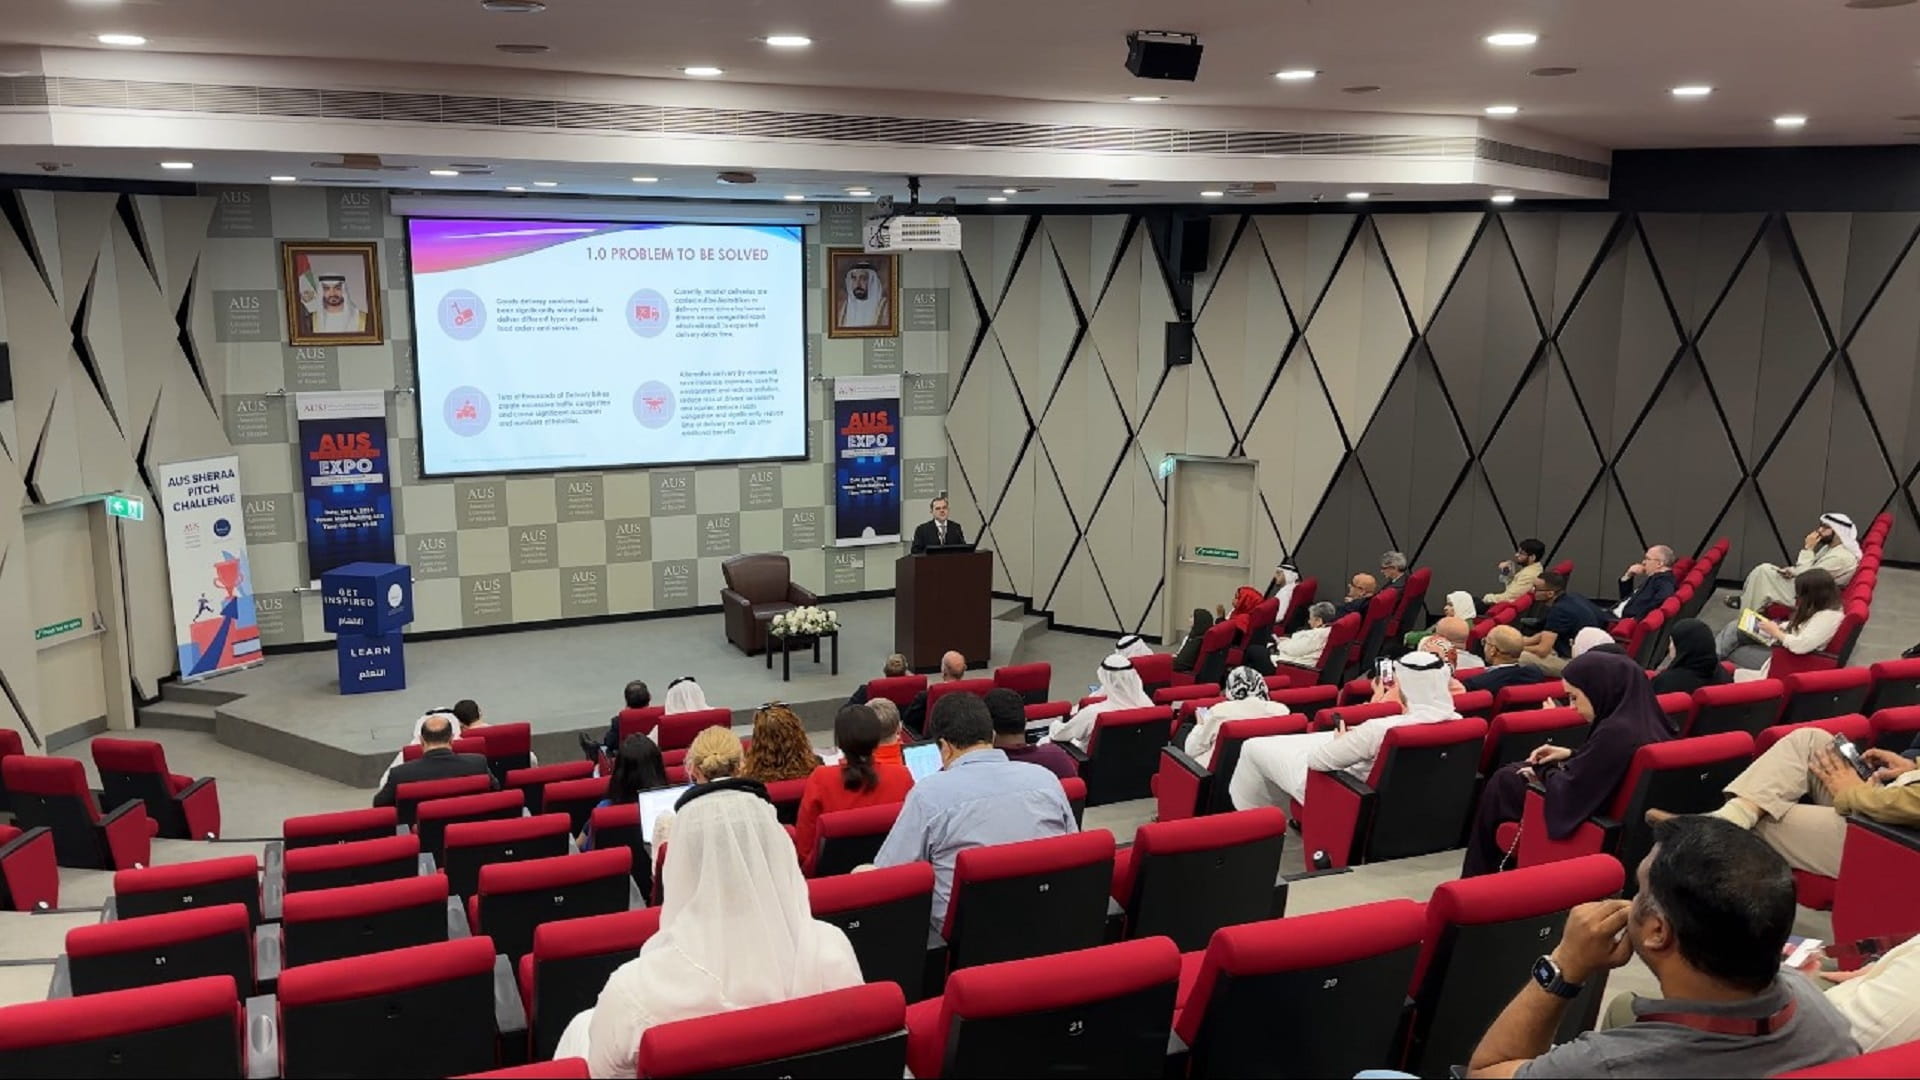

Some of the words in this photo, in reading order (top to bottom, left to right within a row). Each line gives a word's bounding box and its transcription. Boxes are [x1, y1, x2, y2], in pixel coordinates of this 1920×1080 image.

[220, 192, 250, 203] AUS
[341, 193, 370, 204] AUS
[587, 248, 606, 260] 1.0
[612, 248, 674, 260] PROBLEM
[677, 248, 695, 260] TO
[700, 248, 714, 260] BE
[718, 248, 768, 260] SOLVED
[230, 297, 259, 309] AUS
[914, 294, 935, 304] AUS
[873, 339, 895, 348] AUS
[296, 349, 326, 359] AUS
[913, 380, 935, 389] AUS
[237, 401, 267, 412] AUS
[849, 411, 888, 428] AUS
[319, 432, 371, 450] AUS
[848, 434, 888, 448] EXPO
[319, 458, 373, 475] EXPO
[914, 463, 935, 472] AUS
[168, 474, 190, 487] AUS
[192, 469, 235, 484] SHERAA
[750, 472, 773, 482] AUS
[568, 482, 592, 493] AUS
[661, 478, 686, 488] AUS
[188, 484, 219, 497] PITCH
[468, 487, 494, 499] AUS
[173, 494, 236, 512] CHALLENGE
[246, 501, 274, 512] AUS
[706, 518, 730, 529] AUS
[793, 513, 815, 523] AUS
[616, 524, 640, 535] AUS
[520, 530, 547, 542] AUS
[418, 538, 446, 550] AUS
[834, 554, 856, 564] AUS
[664, 565, 688, 576] AUS
[572, 572, 597, 583] AUS
[473, 579, 500, 592] AUS
[339, 588, 358, 596] GET
[324, 596, 374, 607] INSPIRED
[351, 646, 390, 657] LEARN
[1323, 978, 1338, 988] 20
[1069, 1020, 1083, 1032] 21
